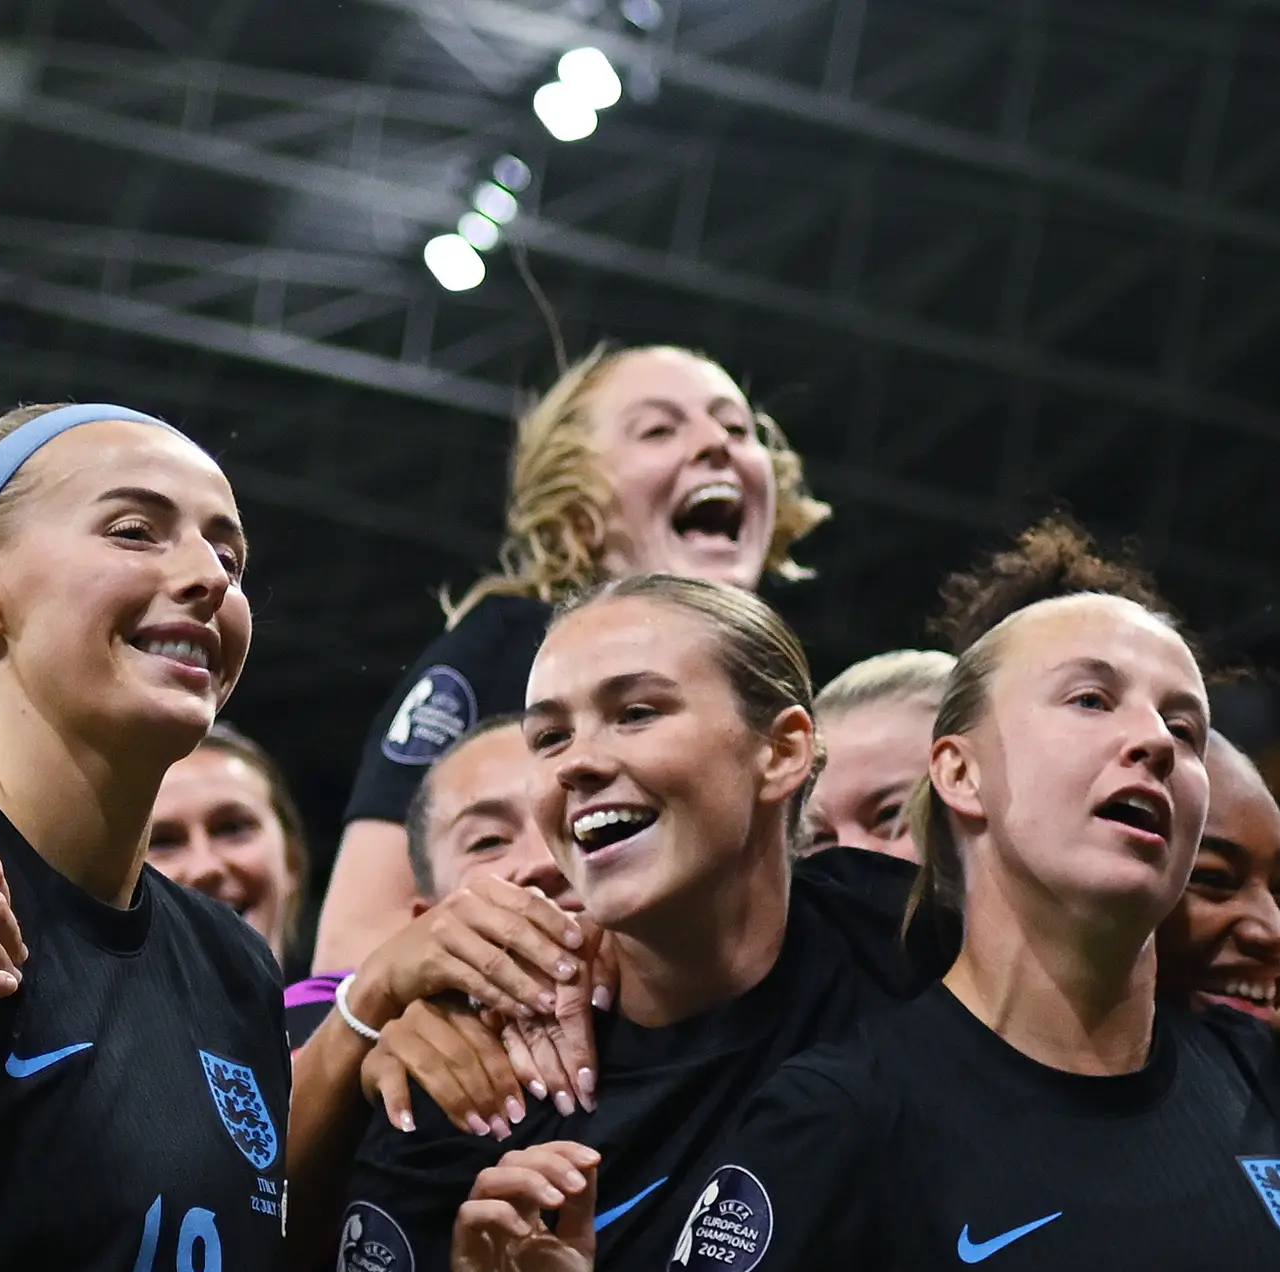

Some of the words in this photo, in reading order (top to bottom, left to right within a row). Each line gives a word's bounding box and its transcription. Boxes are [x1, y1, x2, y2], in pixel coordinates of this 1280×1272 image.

[719, 1203, 749, 1220] UEFA
[702, 1215, 758, 1240] EUROPEAN
[696, 1227, 756, 1253] CHAMPIONS
[698, 1242, 735, 1264] 2022
